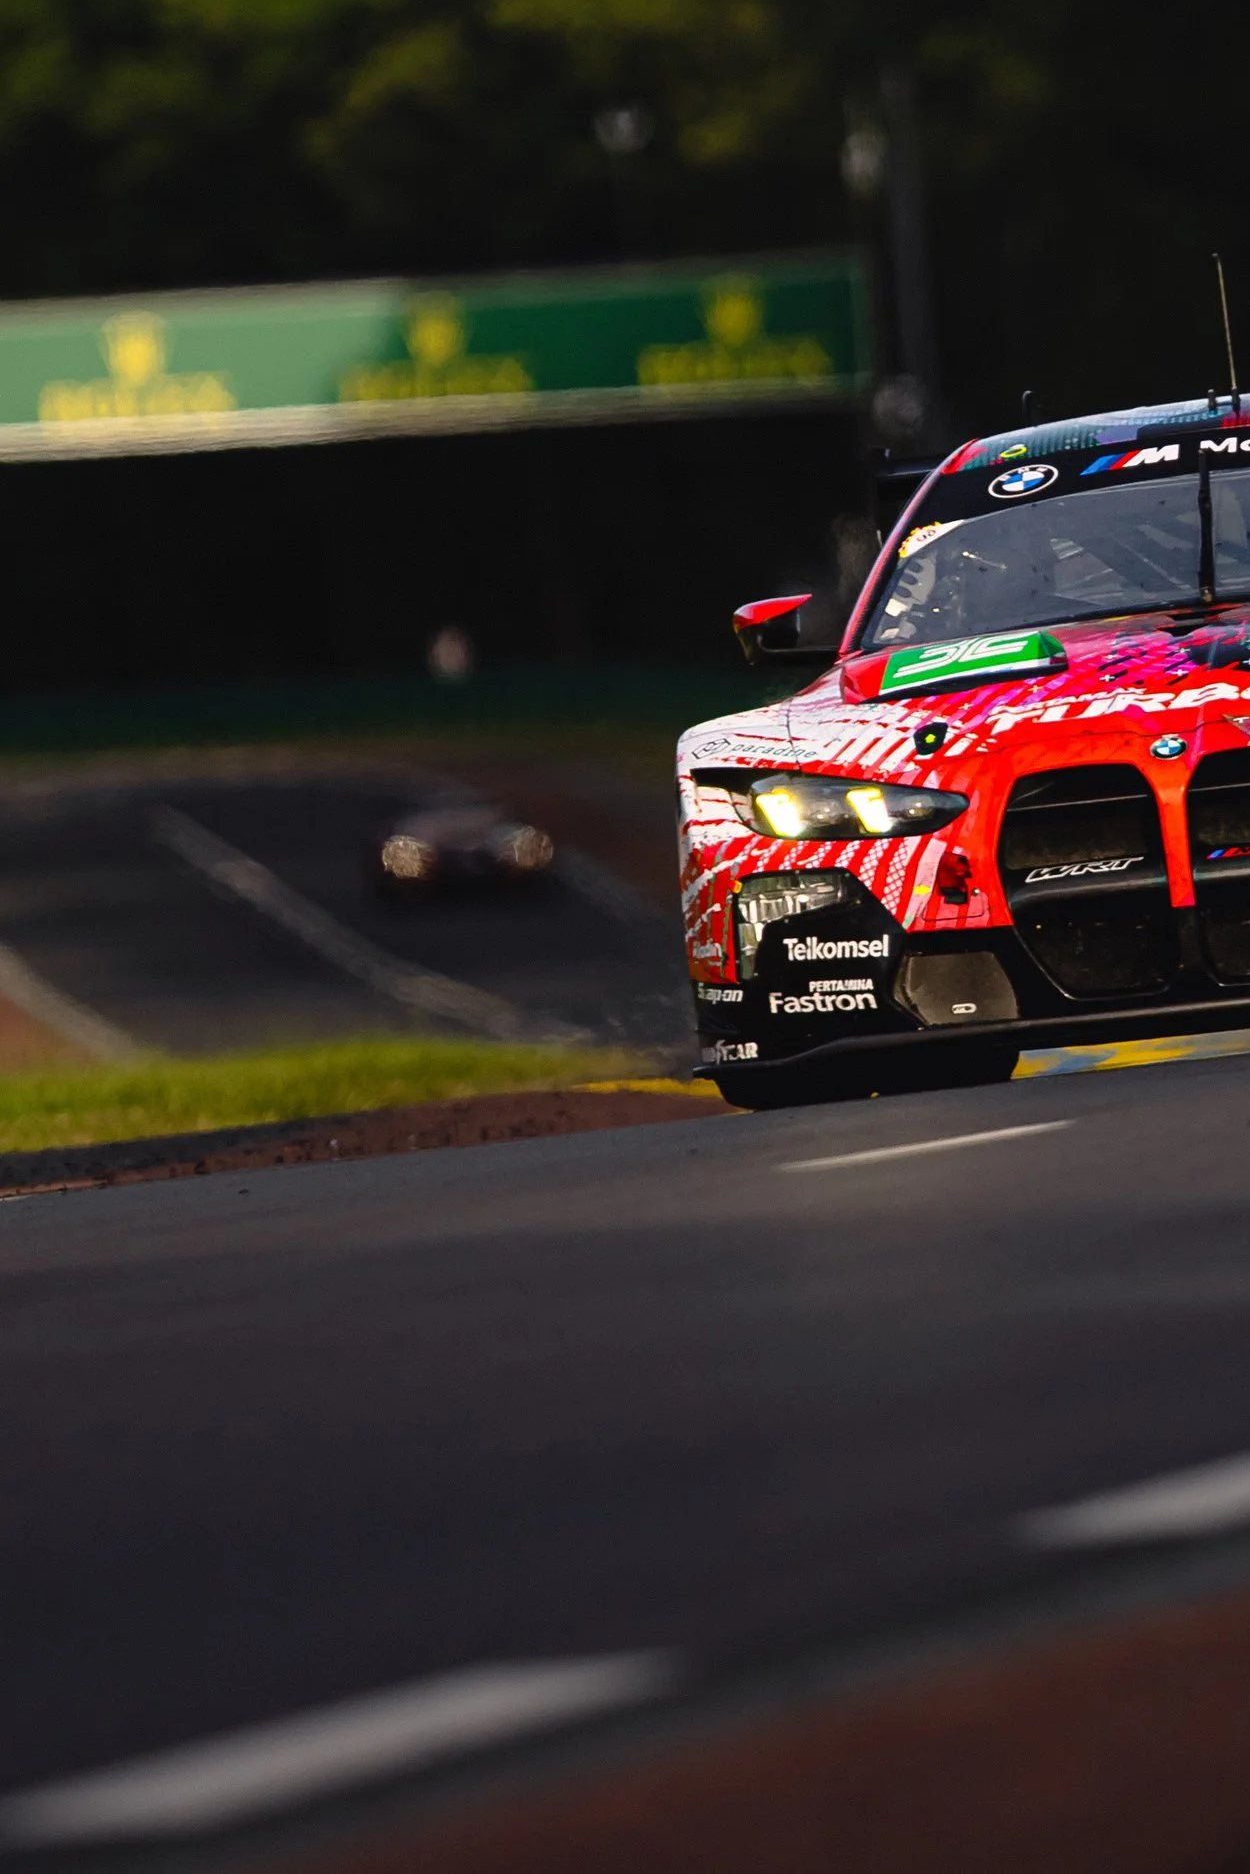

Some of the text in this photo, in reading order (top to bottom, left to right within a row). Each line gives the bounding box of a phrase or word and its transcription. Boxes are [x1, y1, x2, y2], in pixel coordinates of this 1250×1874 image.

[731, 743, 818, 758] paradine
[1025, 856, 1145, 884] WRT
[782, 934, 890, 961] Telkomsel
[808, 978, 874, 993] PERTAMINA
[768, 992, 878, 1014] Fastron
